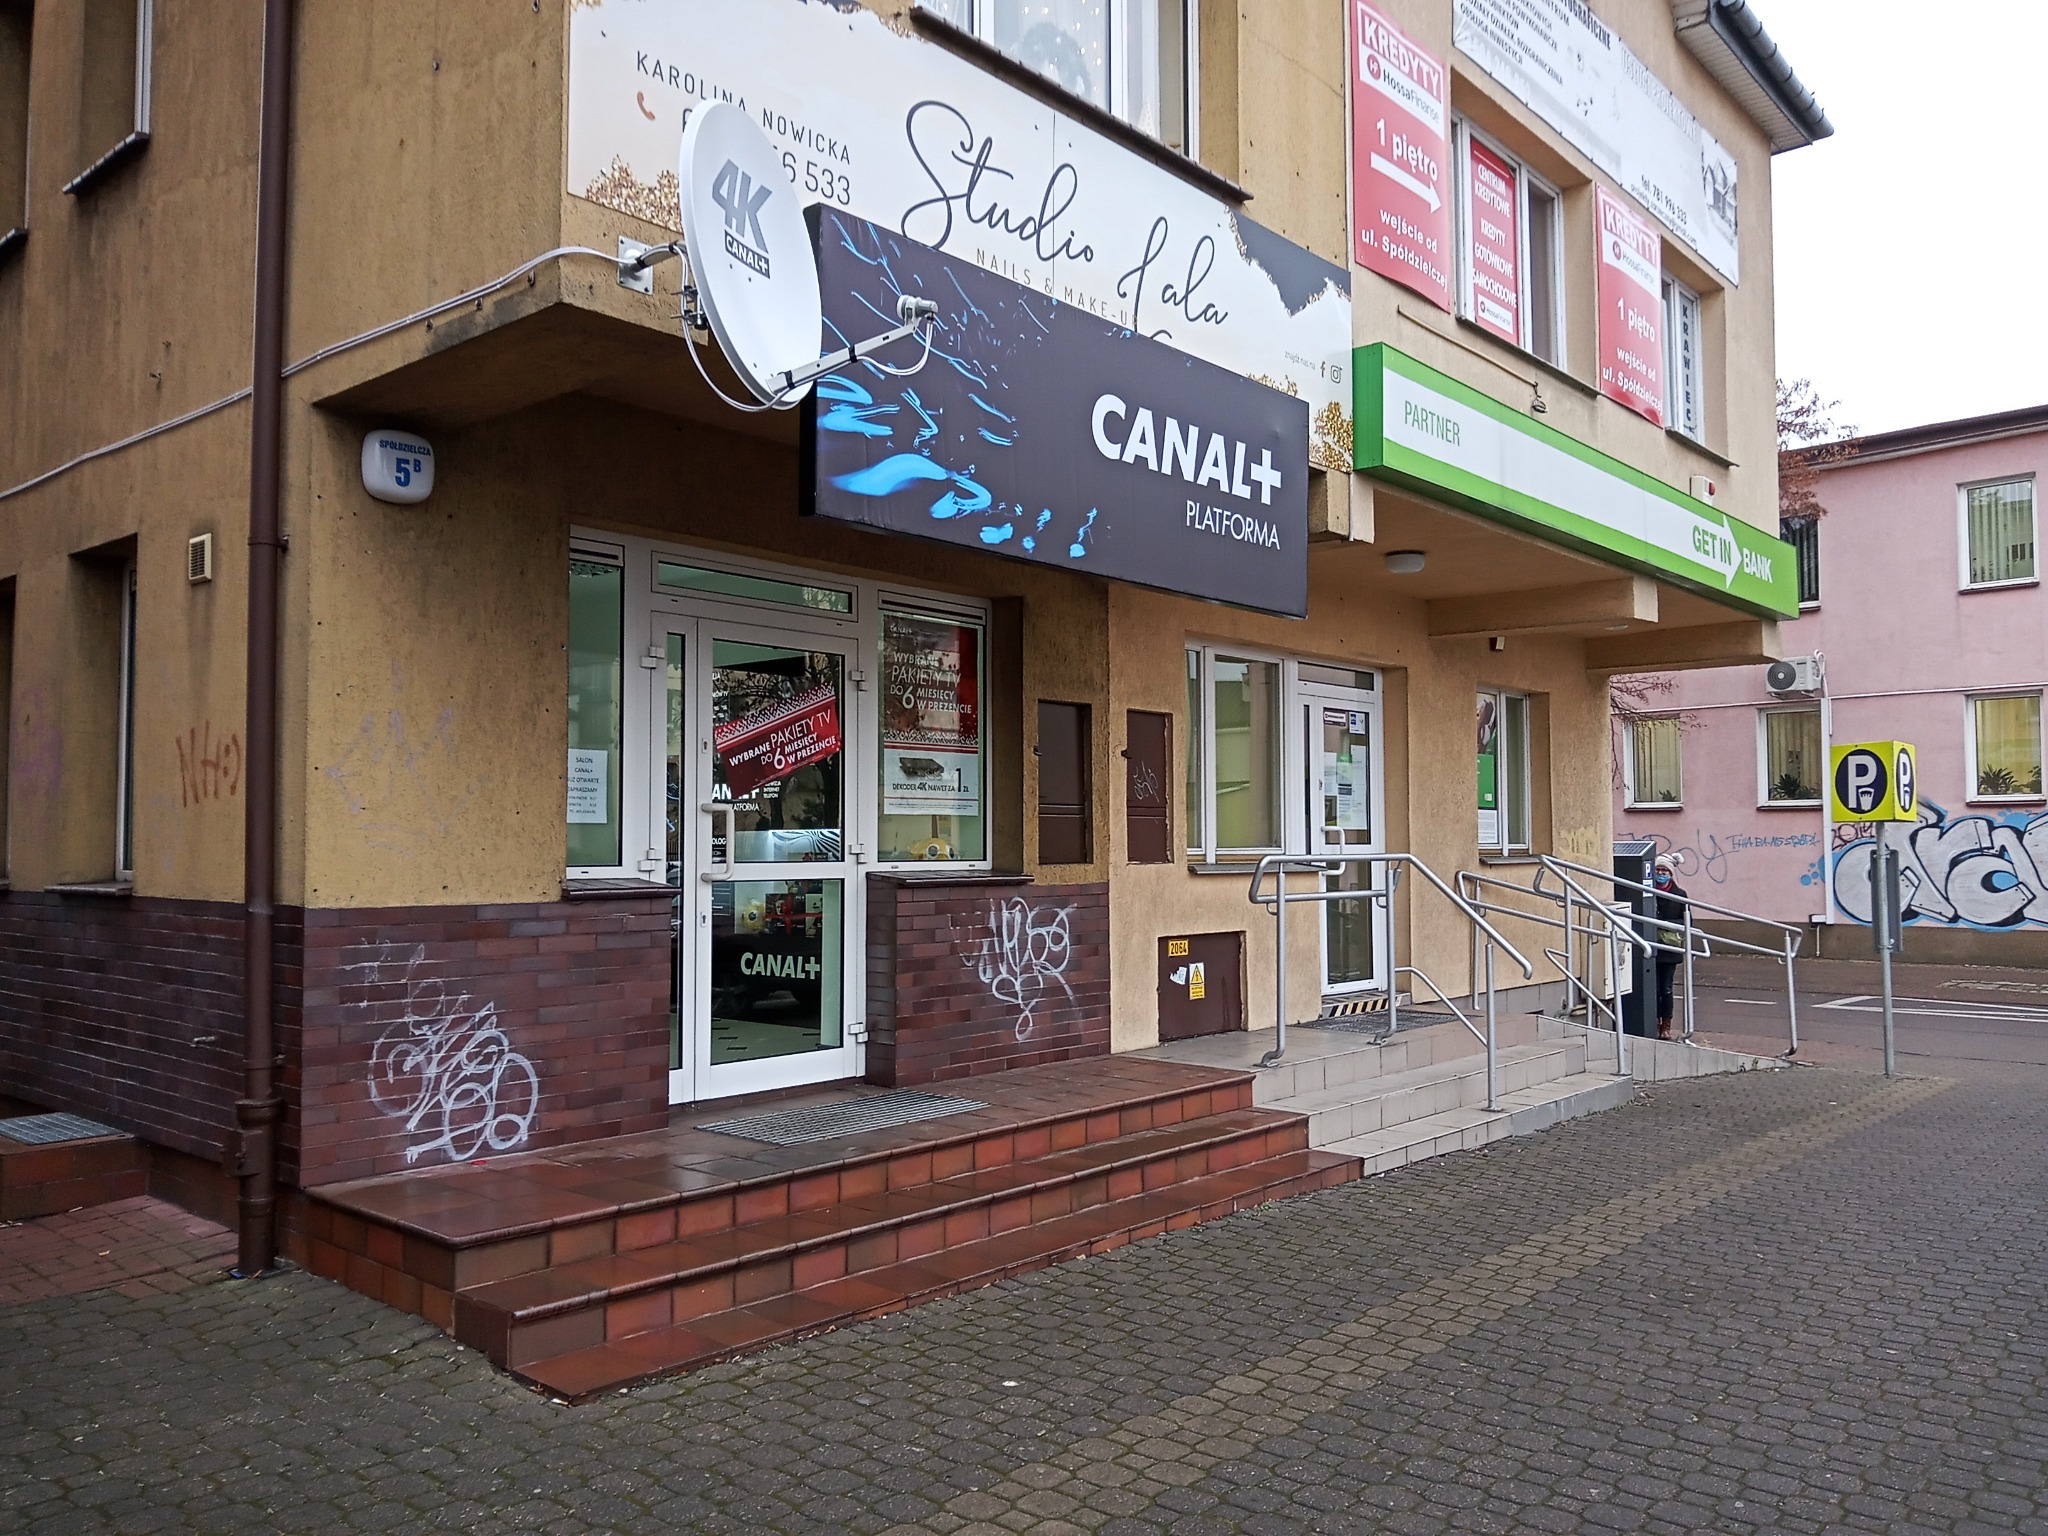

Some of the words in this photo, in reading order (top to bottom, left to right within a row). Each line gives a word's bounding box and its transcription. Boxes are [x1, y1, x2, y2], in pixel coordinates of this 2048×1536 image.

[1364, 15, 1439, 98] KREDYTY
[1383, 68, 1440, 124] HossaFinanse
[762, 107, 851, 165] NOWICKA
[1376, 118, 1386, 147] 1
[1392, 132, 1439, 182] piętro
[804, 160, 851, 206] 533
[900, 98, 1095, 263] Studio
[1474, 179, 1511, 218] KREDYTOWE
[1477, 163, 1507, 197] CENTRUM
[711, 158, 773, 255] 4K
[1380, 208, 1424, 245] wejście
[1426, 237, 1438, 254] od
[1480, 217, 1507, 248] KREDYTY
[1605, 203, 1658, 267] KREDYTY
[725, 237, 769, 275] CANAL+
[976, 247, 1032, 286] NAILS
[1044, 277, 1053, 295] &
[1361, 229, 1378, 249] ul.
[1382, 234, 1448, 293] Spółdzielczej
[1474, 241, 1514, 280] GOTÓWKOWE
[1472, 267, 1518, 309] SAMOCHODOWE
[1617, 297, 1625, 321] 1
[1628, 307, 1656, 343] piętro
[1617, 346, 1647, 376] wejście
[1648, 366, 1657, 382] od
[1682, 304, 1693, 422] KRAWIEC
[1602, 366, 1616, 383] ul.
[1617, 371, 1664, 416] Spółdzielczej
[1404, 400, 1461, 448] PARTNER
[379, 439, 432, 457] SPÓŁDZIELCZA
[1091, 393, 1282, 506] CANAL+
[1186, 499, 1281, 551] PLATFORMA
[1742, 547, 1773, 584] BANK
[891, 665, 943, 686] PAKIETY
[946, 671, 962, 688] TV
[893, 651, 940, 668] WYBRANE
[890, 684, 904, 696] DO
[902, 685, 915, 709] 6
[916, 687, 955, 701] MIESIĘCY
[916, 699, 927, 710] W
[928, 700, 973, 714] PREZENCIE
[575, 756, 593, 764] SALON
[728, 741, 772, 767] WYBRANE
[770, 715, 815, 749] PAKIETY
[816, 708, 831, 728] TV
[761, 752, 774, 766] DO
[773, 747, 786, 770] 6
[784, 732, 818, 755] MIESIĘCY
[786, 753, 797, 765] W
[797, 735, 837, 761] PREZENCIE
[892, 783, 917, 791] DEKODER
[917, 782, 928, 791] 4K
[1847, 754, 1878, 809] P
[1899, 752, 1911, 807] P
[740, 951, 821, 980] CANAL+
[1170, 941, 1187, 955] 2064
